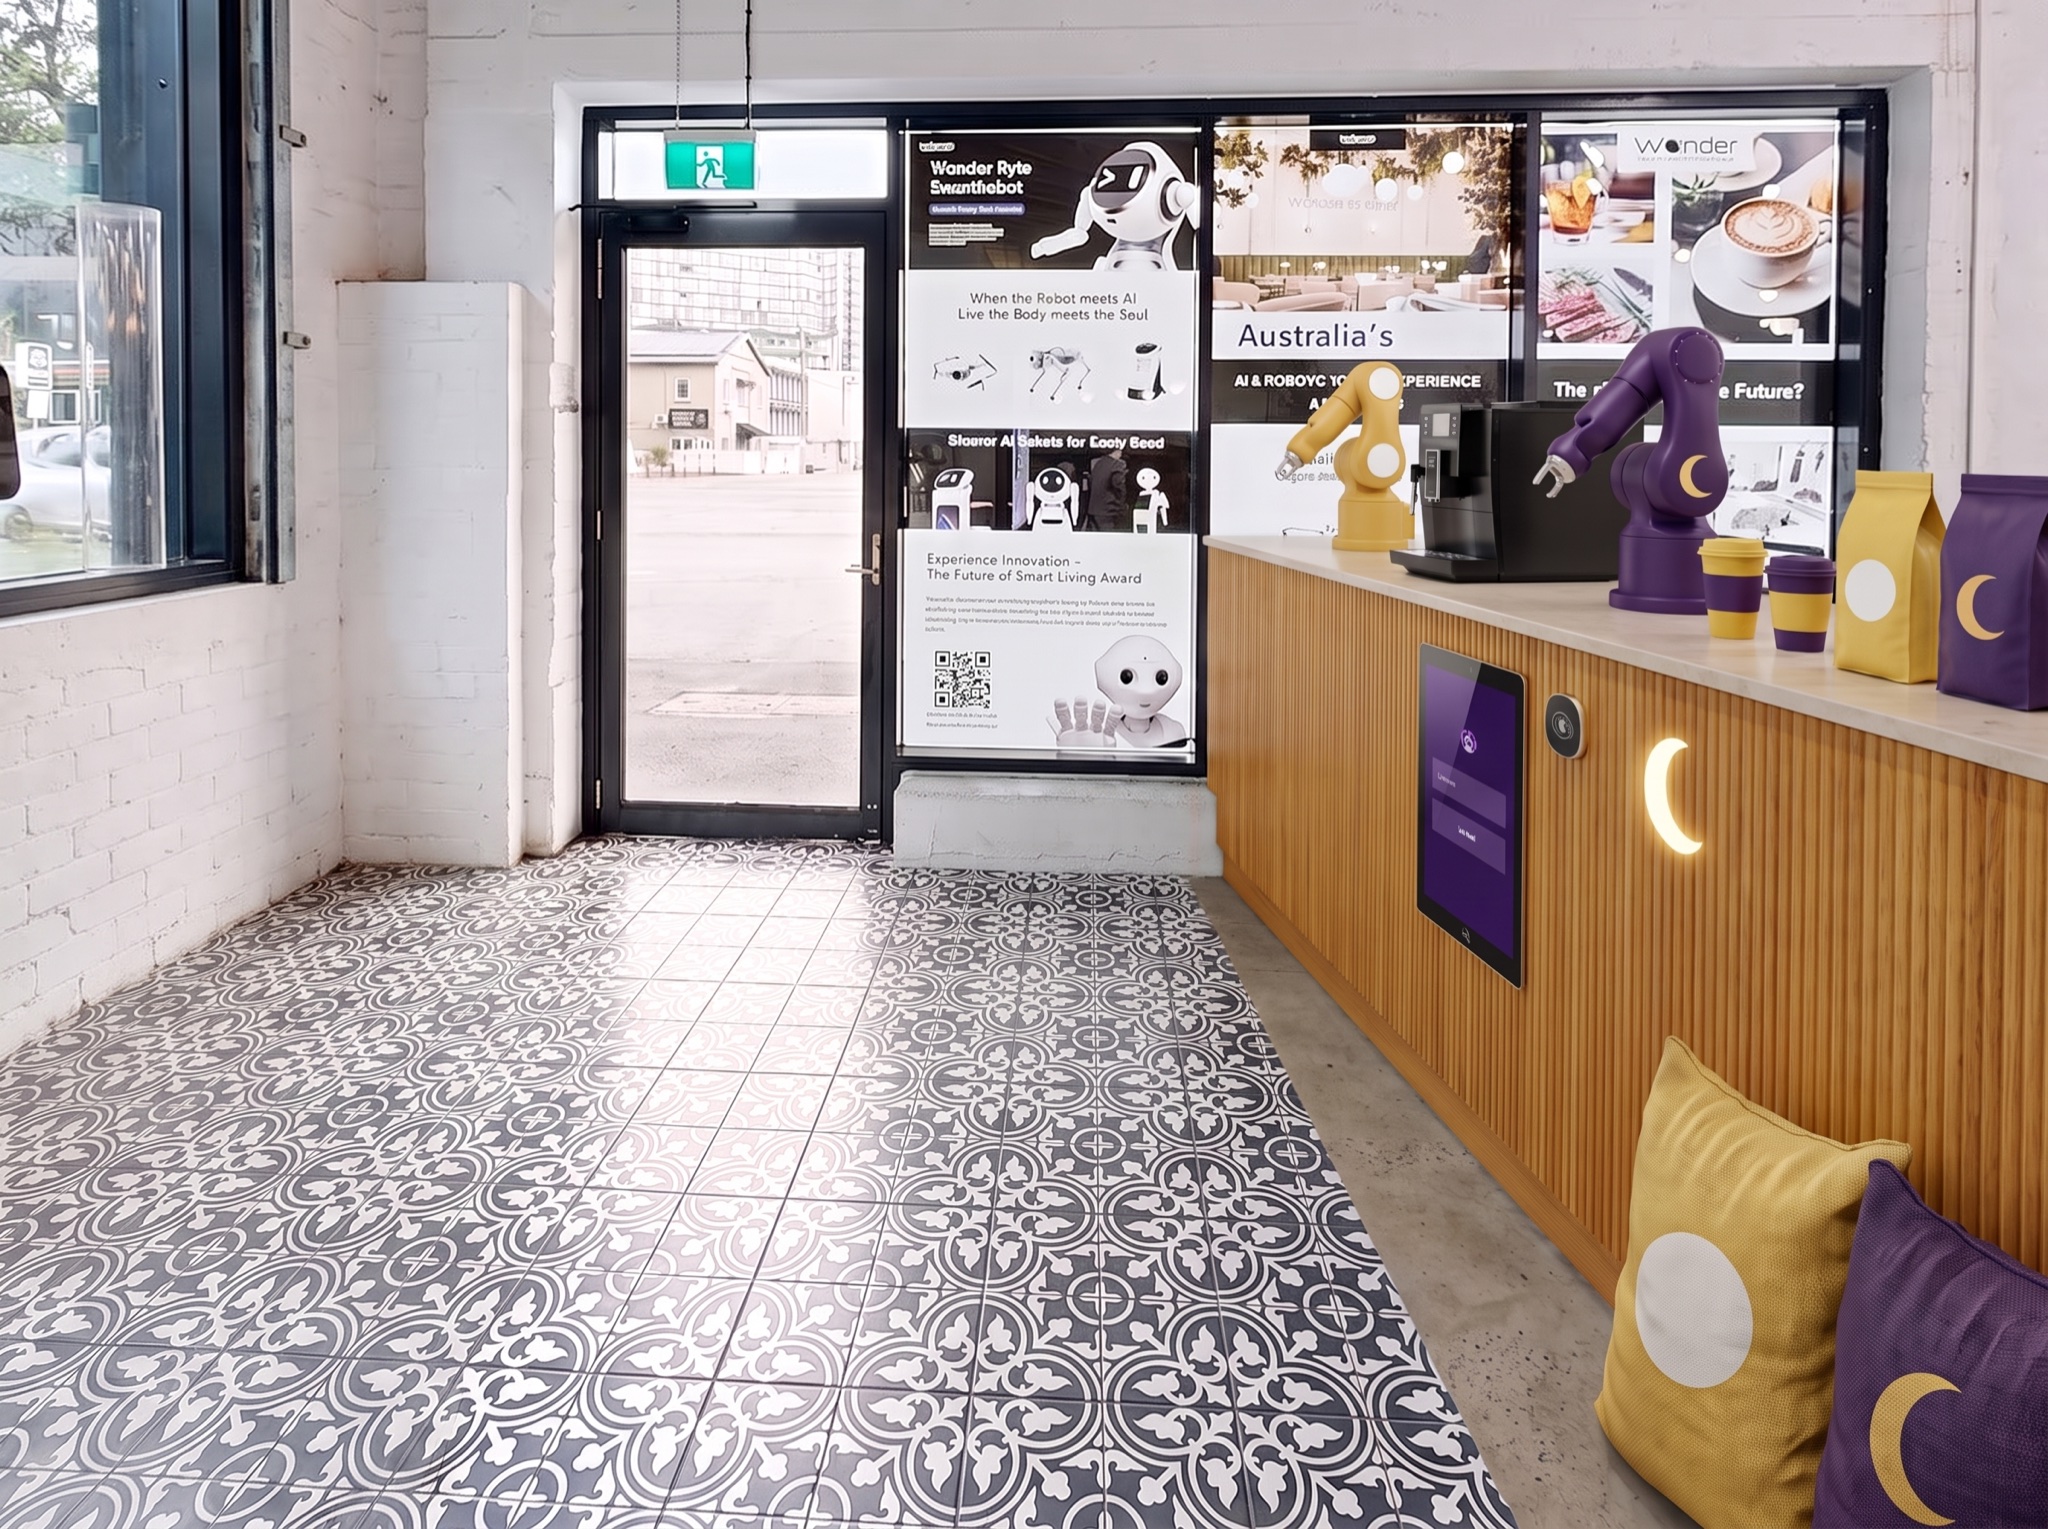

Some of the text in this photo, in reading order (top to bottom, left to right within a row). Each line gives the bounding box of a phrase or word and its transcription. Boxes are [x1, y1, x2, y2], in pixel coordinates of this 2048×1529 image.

[997, 160, 1033, 179] Ryte
[970, 292, 1137, 304] When the Robot meets AI
[958, 308, 984, 320] Live
[989, 308, 1009, 320] the
[1013, 308, 1047, 323] Body
[1051, 309, 1090, 320] meets
[1094, 309, 1115, 320] the
[1234, 374, 1249, 387] AI
[1251, 374, 1262, 387] &
[1553, 381, 1587, 398] The
[1734, 382, 1805, 400] Future?
[1066, 435, 1087, 449] for
[927, 553, 998, 570] Experience
[1002, 554, 1070, 567] Innovation
[927, 569, 1142, 586] The Future of Smart Living Award
